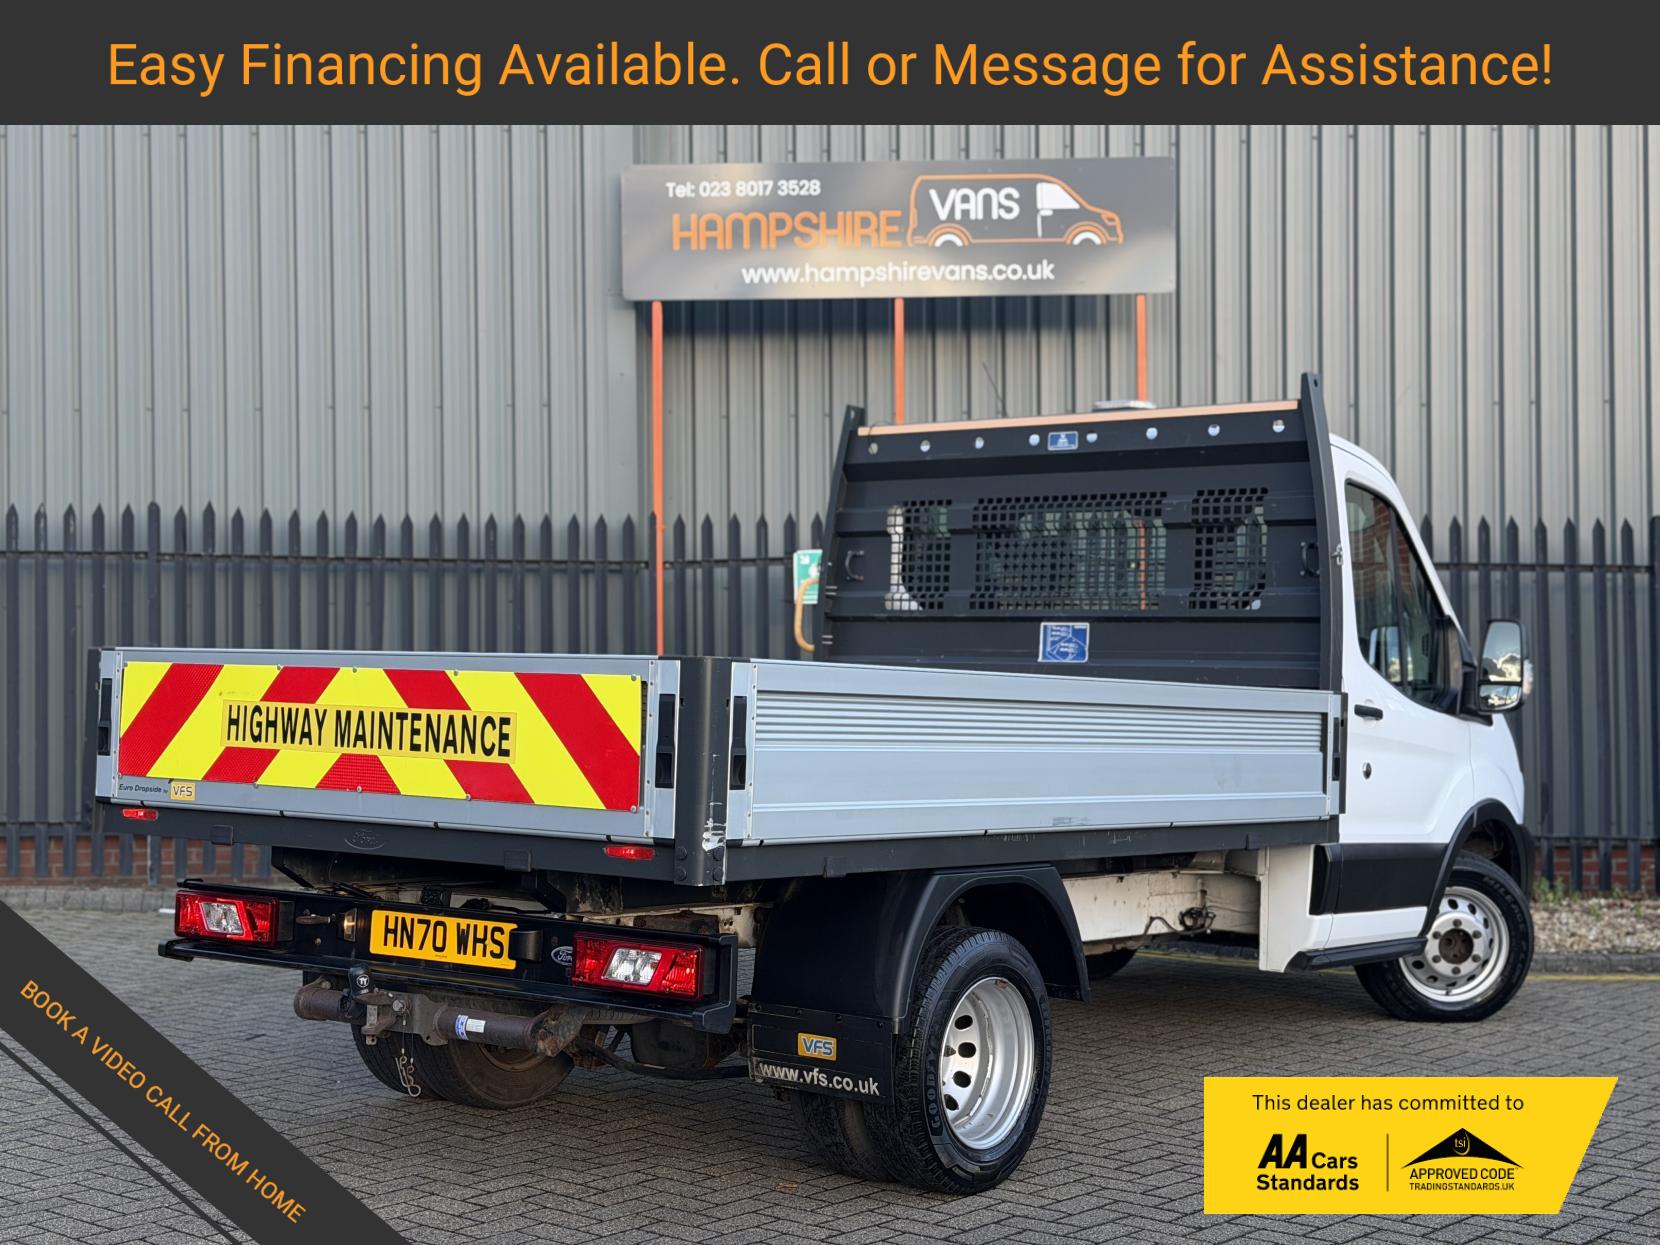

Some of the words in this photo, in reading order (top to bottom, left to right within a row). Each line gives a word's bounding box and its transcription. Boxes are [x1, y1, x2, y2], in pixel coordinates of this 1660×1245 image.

[666, 182, 695, 198] Tel:
[699, 181, 732, 197] 023
[735, 180, 773, 197] 8017
[777, 179, 821, 196] 3528
[672, 210, 902, 251] HAMPSHIRE
[929, 187, 1020, 221] VANS
[741, 259, 1055, 287] www.hampshirevans.co.uk
[227, 704, 328, 746] HIGHWAY
[334, 709, 511, 758] MAINTENANCE
[119, 783, 133, 791] Euro
[172, 786, 193, 797] VFS
[383, 914, 448, 953] HN70
[456, 921, 505, 960] WHS
[801, 1037, 833, 1056] VFS
[760, 1062, 880, 1096] www.vfs.co.uk
